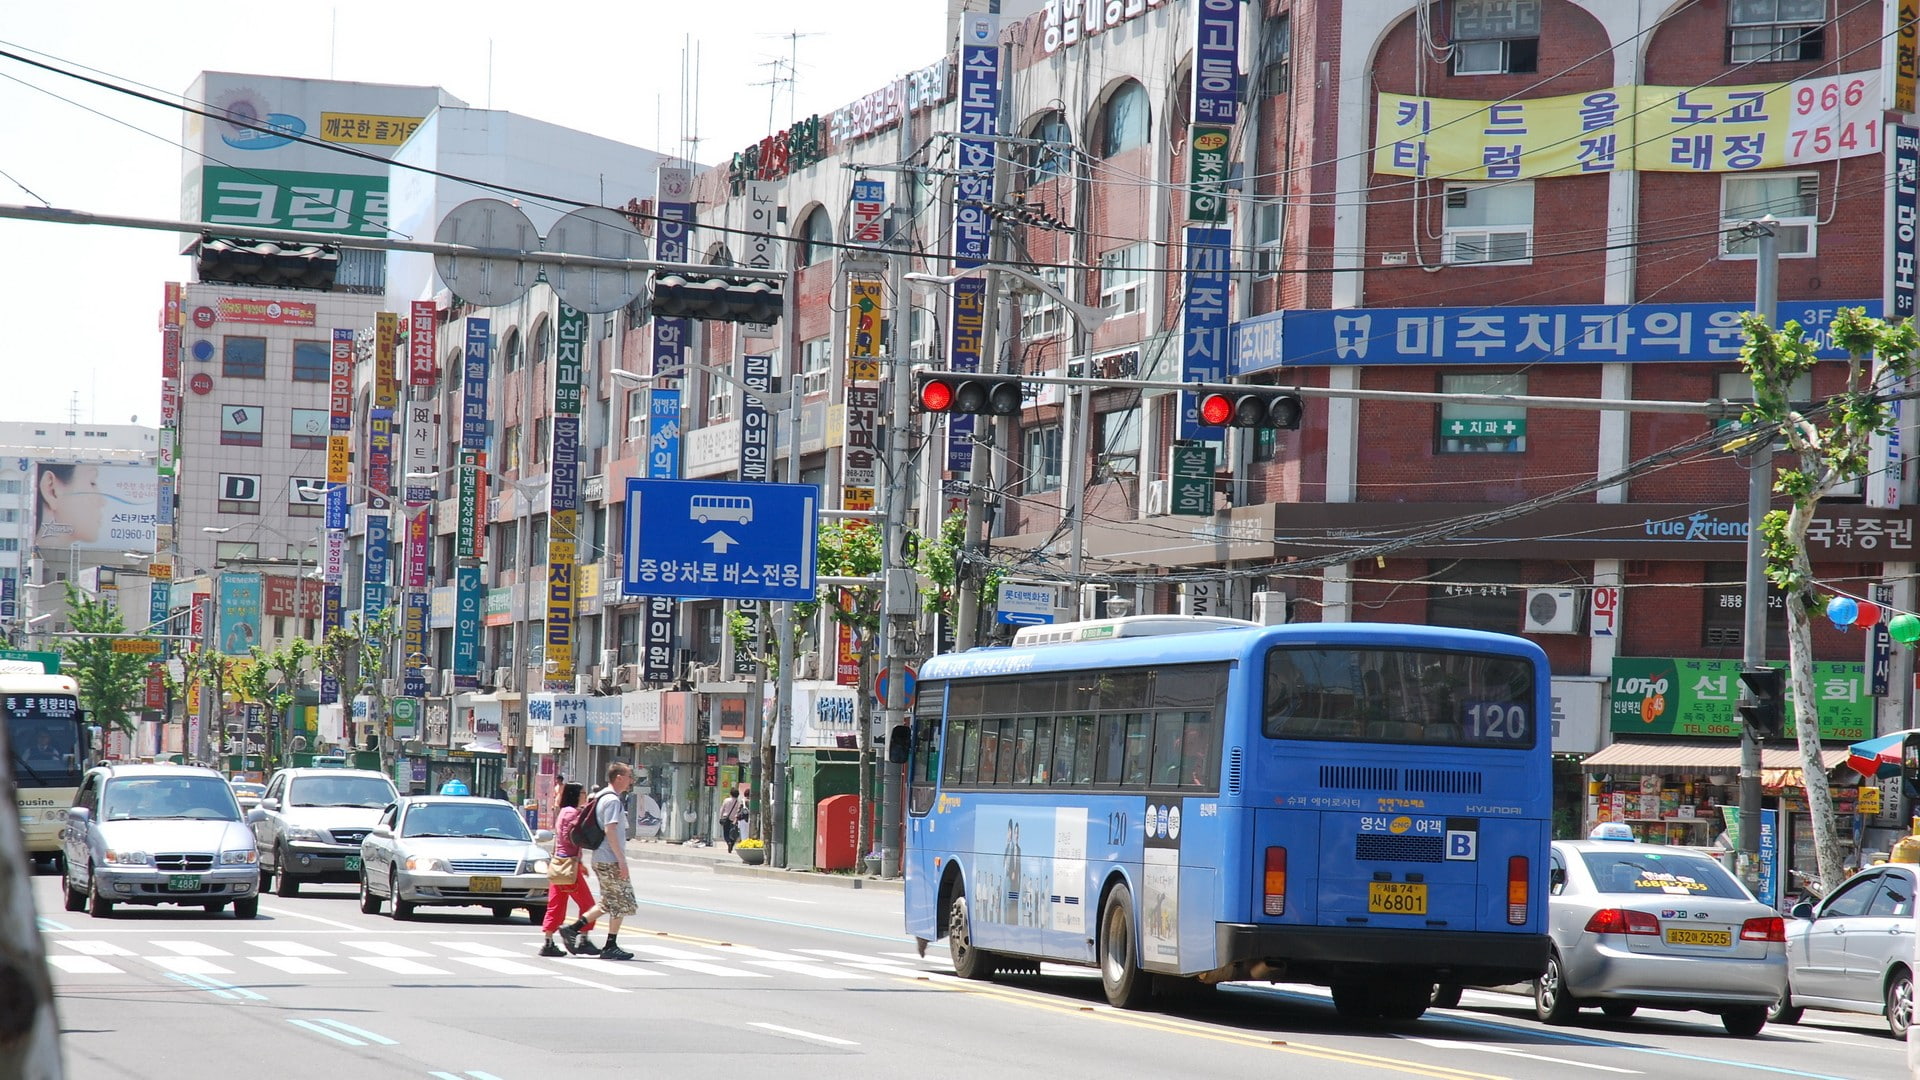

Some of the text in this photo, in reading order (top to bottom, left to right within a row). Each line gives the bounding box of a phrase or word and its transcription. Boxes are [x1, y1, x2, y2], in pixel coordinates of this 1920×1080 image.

[1796, 79, 1865, 116] 966
[1198, 98, 1234, 118] 학교
[325, 117, 371, 138] 깨끗한
[1793, 119, 1878, 157] 7541
[1897, 296, 1912, 309] 3F
[1803, 308, 1831, 325] 3F
[332, 342, 351, 414] 중화요리
[465, 322, 489, 421] 노재철내과
[556, 388, 580, 401] 의원
[373, 420, 390, 450] 미주
[464, 422, 485, 433] 의원
[1468, 418, 1499, 435] 치과
[225, 476, 256, 500] D
[845, 489, 873, 499] 미주
[551, 498, 575, 509] 의원
[1645, 519, 1685, 536] true
[1806, 518, 1913, 551] 국투자증권
[366, 527, 386, 575] PC방
[149, 564, 171, 577] 전당포
[640, 558, 800, 588] 중앙차로 버스전용
[224, 576, 259, 584] SIEMENS
[1004, 589, 1050, 604] 롯데백화점
[1767, 595, 1784, 609] 구소
[1593, 588, 1618, 628] 약
[459, 598, 476, 660] 오안과
[650, 597, 674, 669] 한의원
[1616, 677, 1669, 699] LOTTO
[38, 698, 77, 712] 청량리역
[1468, 704, 1526, 739] 120
[1683, 723, 1742, 735] TEL.966-
[17, 797, 55, 807] ousine
[1287, 795, 1361, 809] 슈퍼 에어로시티
[1466, 804, 1522, 815] HYUNDAI
[1106, 811, 1128, 847] 120
[1360, 817, 1442, 834] 영신 CNG 여객
[1450, 833, 1472, 857] B
[177, 879, 200, 890] 4887
[1382, 883, 1413, 894] 서울 74
[1370, 893, 1424, 912] 사 6801
[1700, 932, 1728, 946] 2525
